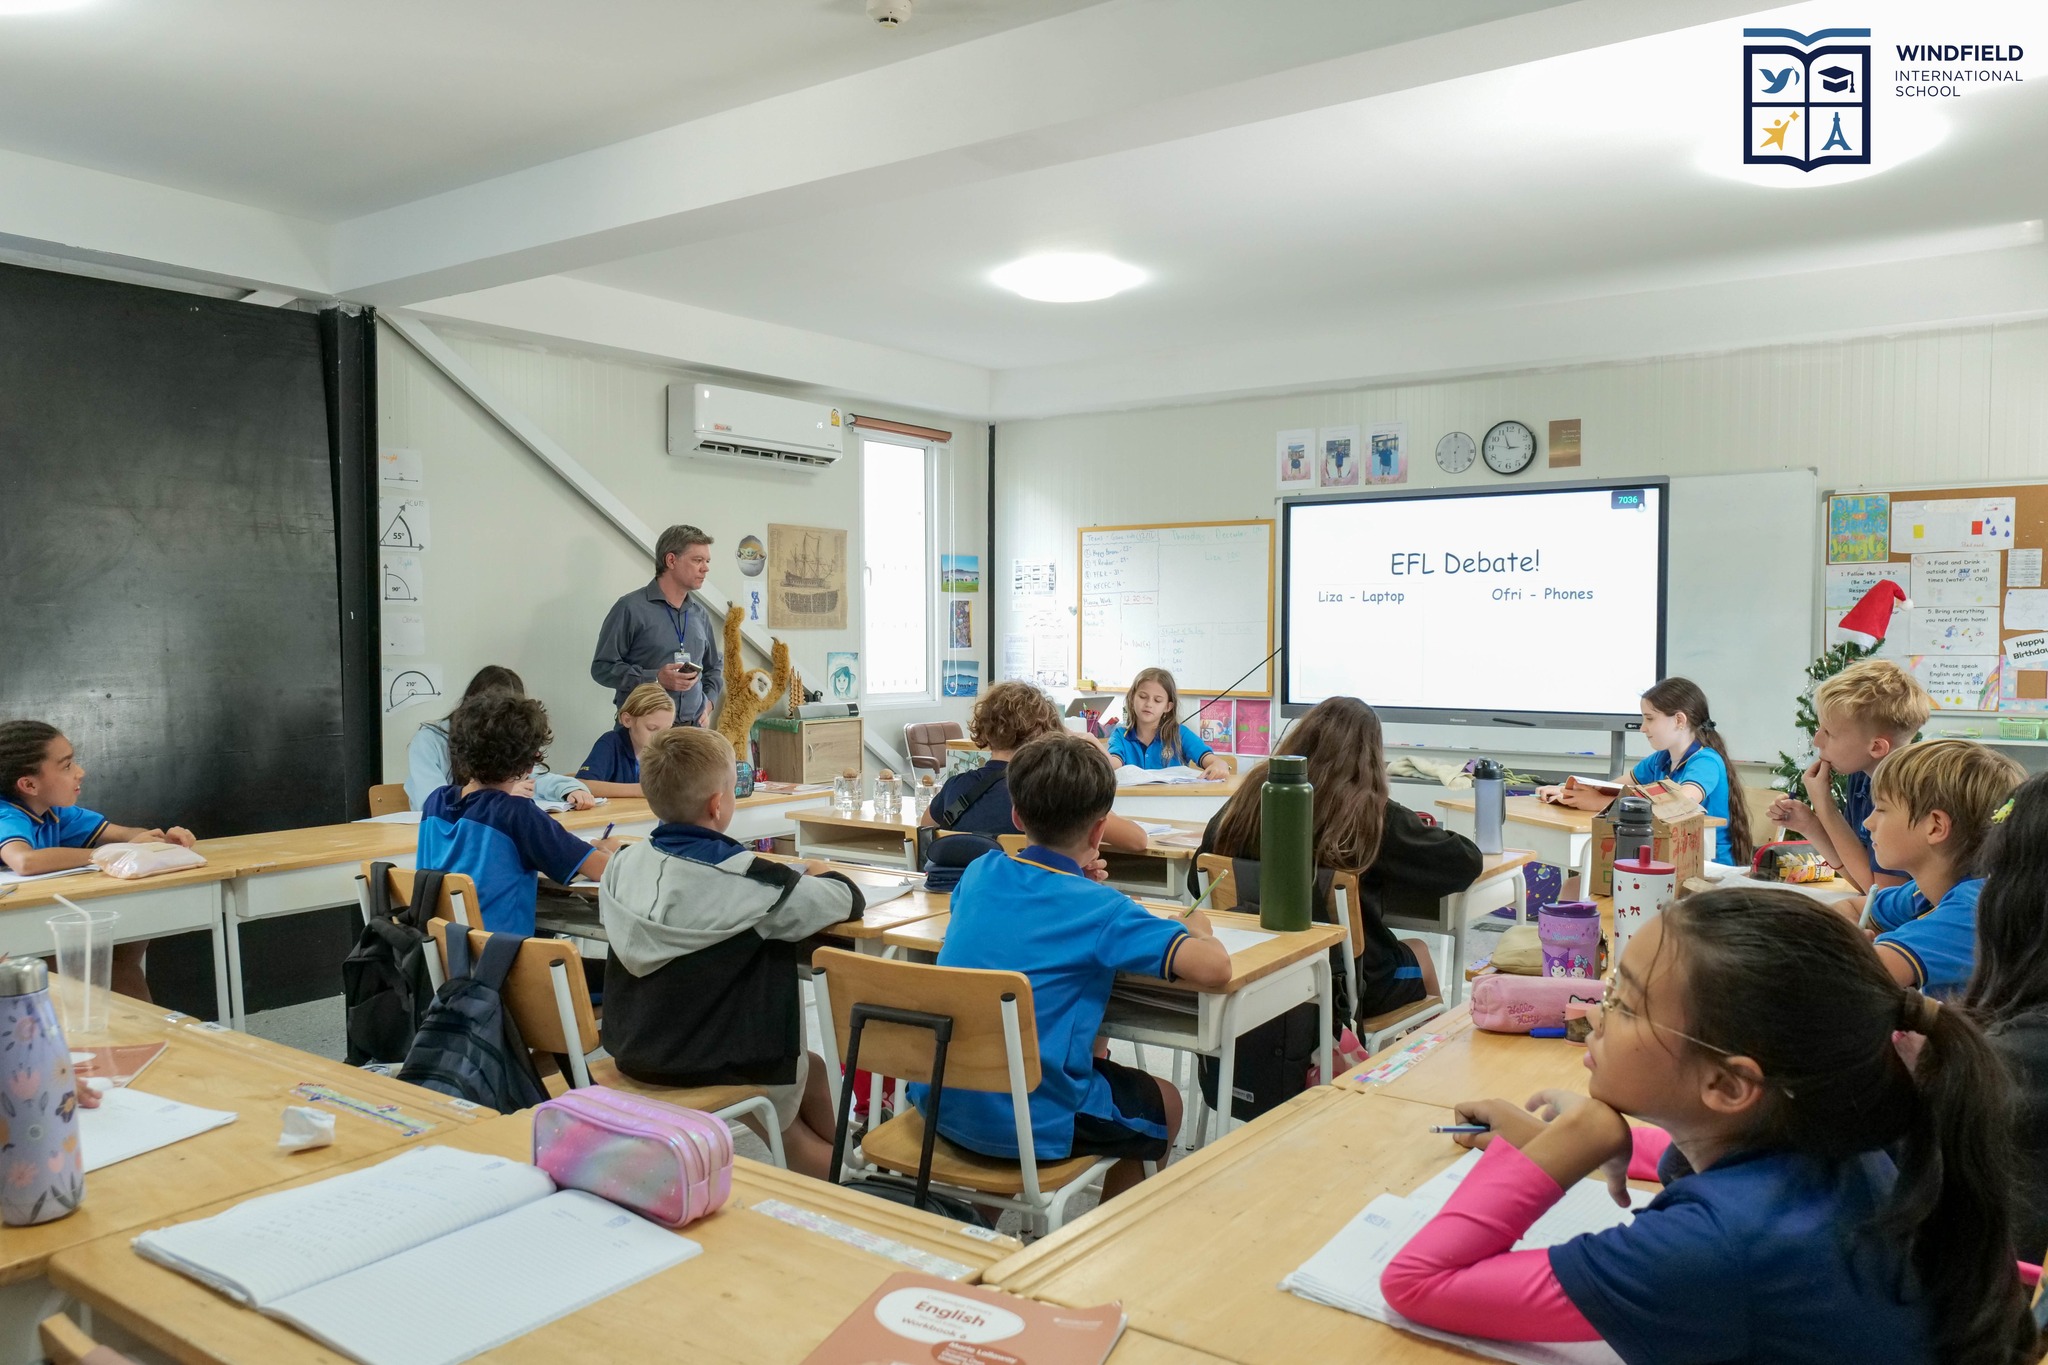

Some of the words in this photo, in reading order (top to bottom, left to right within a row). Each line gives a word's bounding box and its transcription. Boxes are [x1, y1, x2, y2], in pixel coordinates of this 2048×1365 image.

[1618, 496, 1638, 504] 7036
[1390, 552, 1434, 576] EFL
[1444, 548, 1540, 574] Debate!
[1318, 590, 1343, 602] Liza
[1362, 590, 1405, 604] Laptop
[1491, 586, 1522, 601] Ofri
[1544, 587, 1594, 601] Phones
[2016, 638, 2045, 648] Happy
[1507, 1003, 1535, 1015] Hello
[1516, 1015, 1542, 1025] Kitty
[914, 1300, 986, 1327] English
[902, 1317, 956, 1337] Workbook
